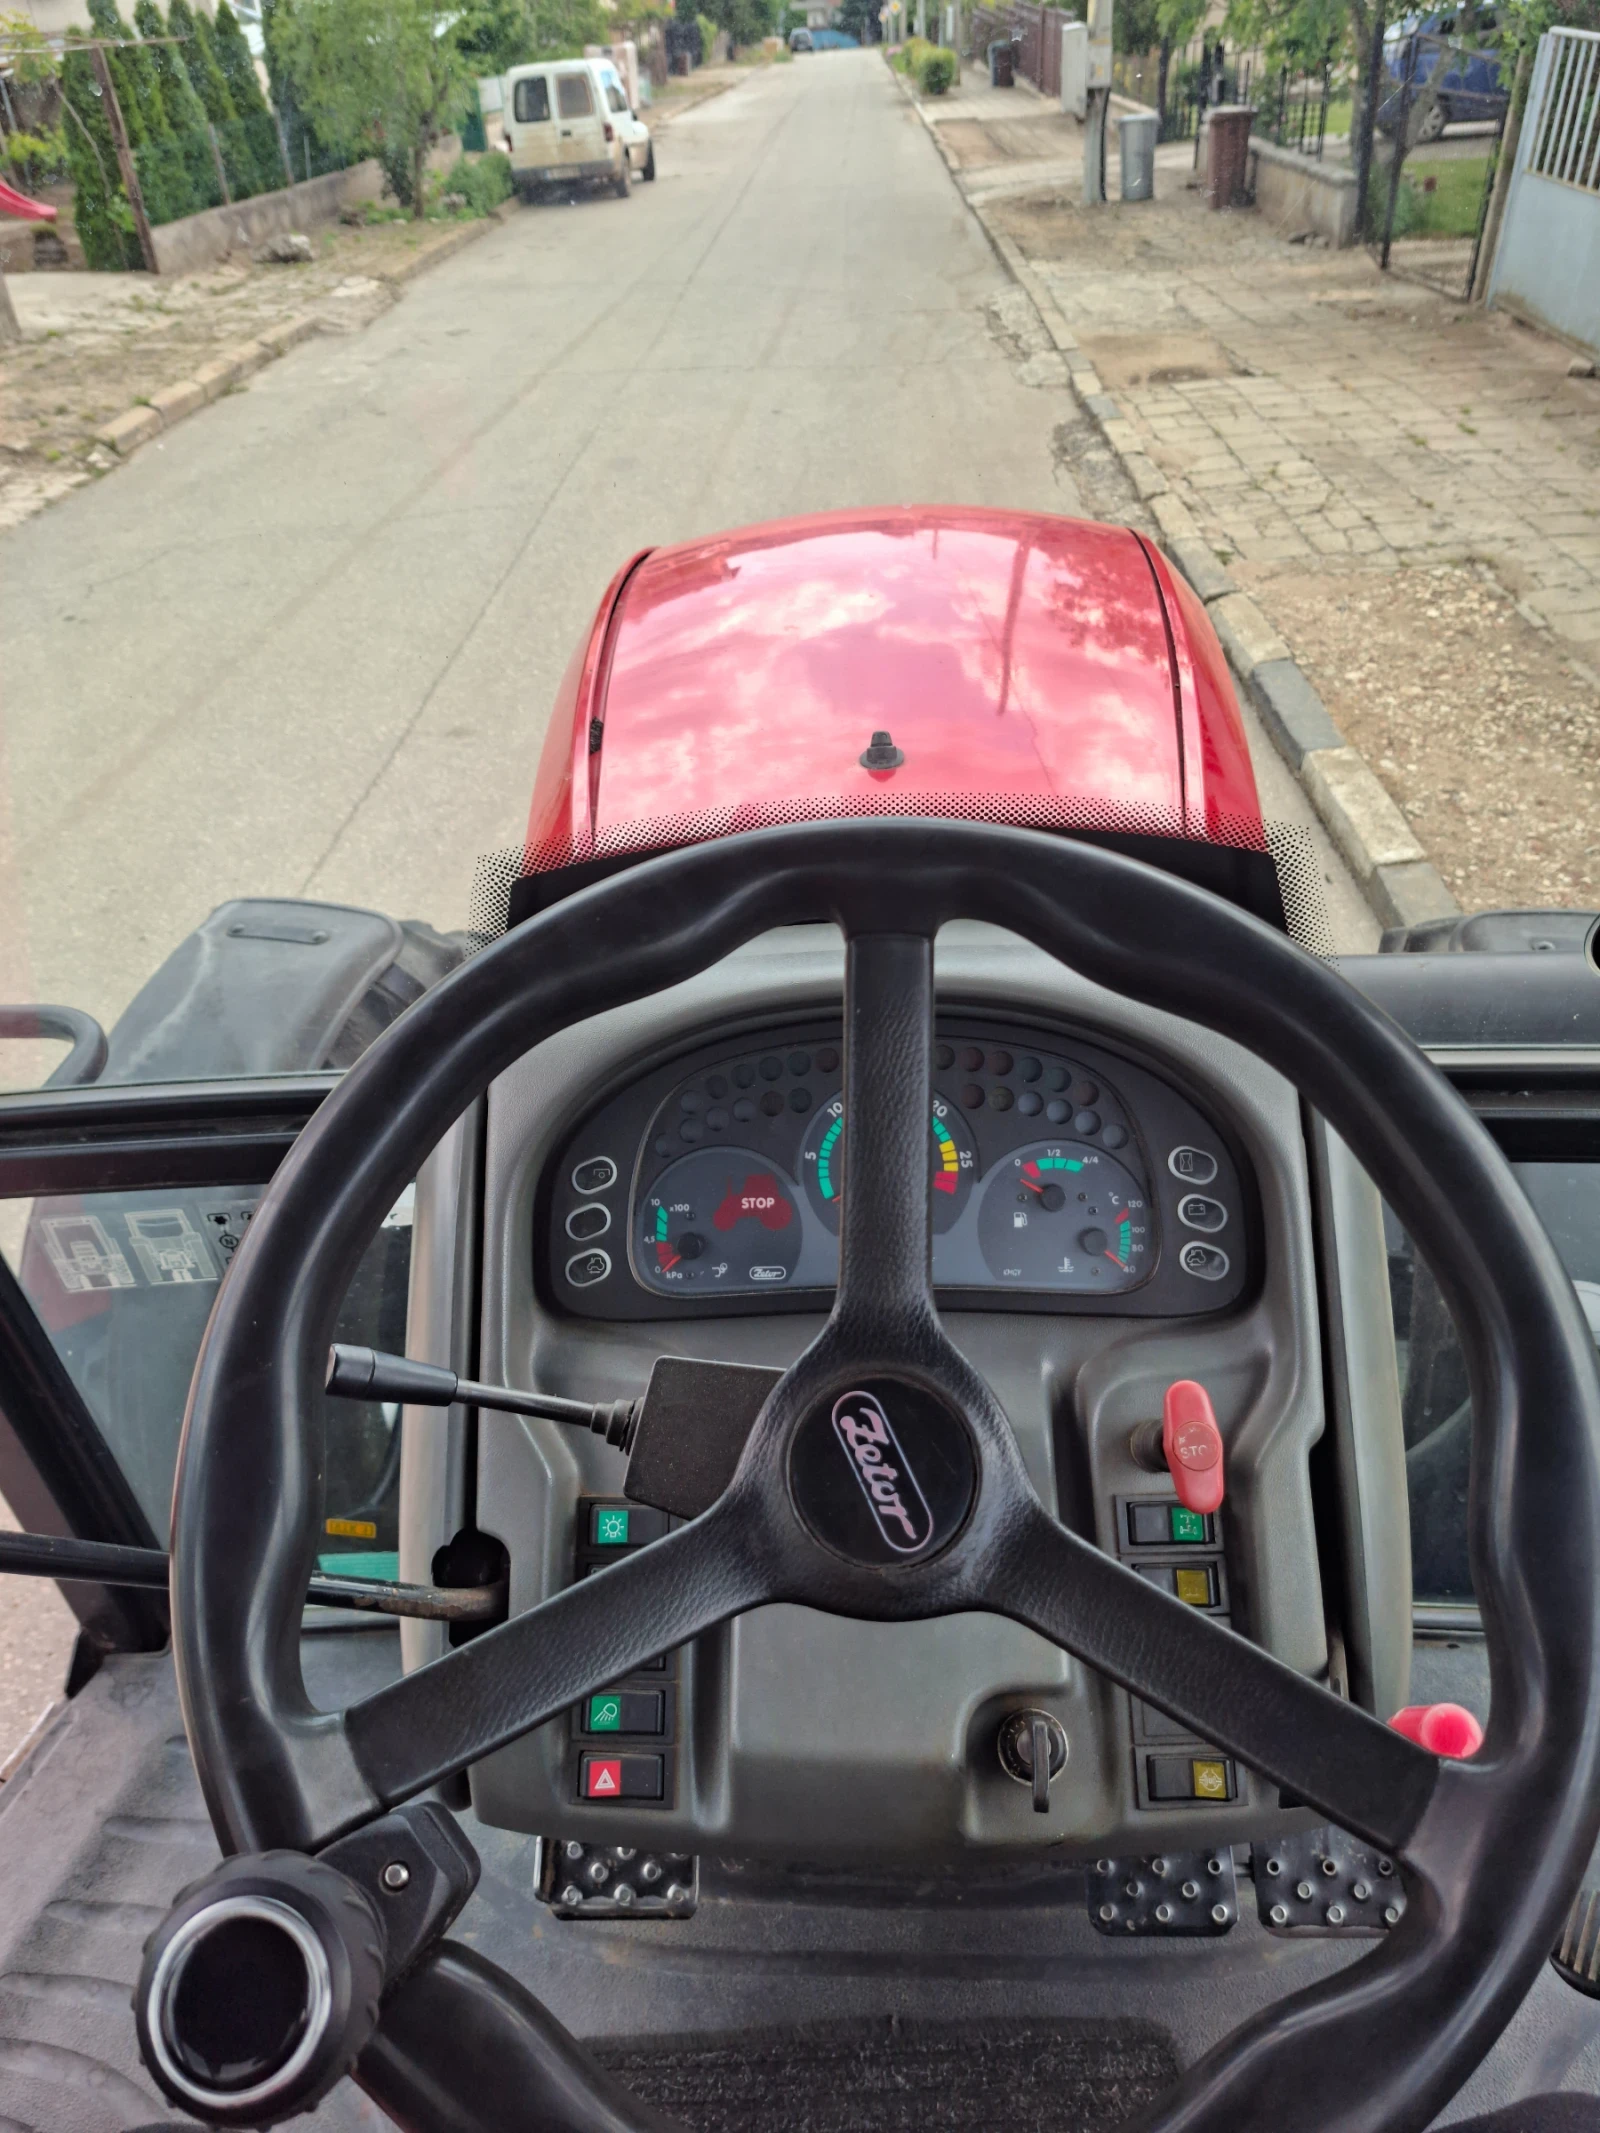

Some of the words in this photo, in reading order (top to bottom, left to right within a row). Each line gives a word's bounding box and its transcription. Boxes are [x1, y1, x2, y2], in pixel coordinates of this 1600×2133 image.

[827, 1102, 843, 1117] 10
[805, 1151, 817, 1160] 5
[1047, 1149, 1061, 1157] 1/2
[960, 1150, 974, 1169] 25
[1014, 1159, 1021, 1167] 0
[1082, 1156, 1099, 1165] 4/4
[651, 1198, 661, 1207] 10
[741, 1197, 775, 1209] STOP
[1128, 1200, 1143, 1208] 120
[1131, 1226, 1146, 1234] 100
[1131, 1244, 1144, 1252] 80
[666, 1270, 683, 1279] kPa
[1122, 1266, 1136, 1274] 40
[839, 1407, 917, 1540] Zetor
